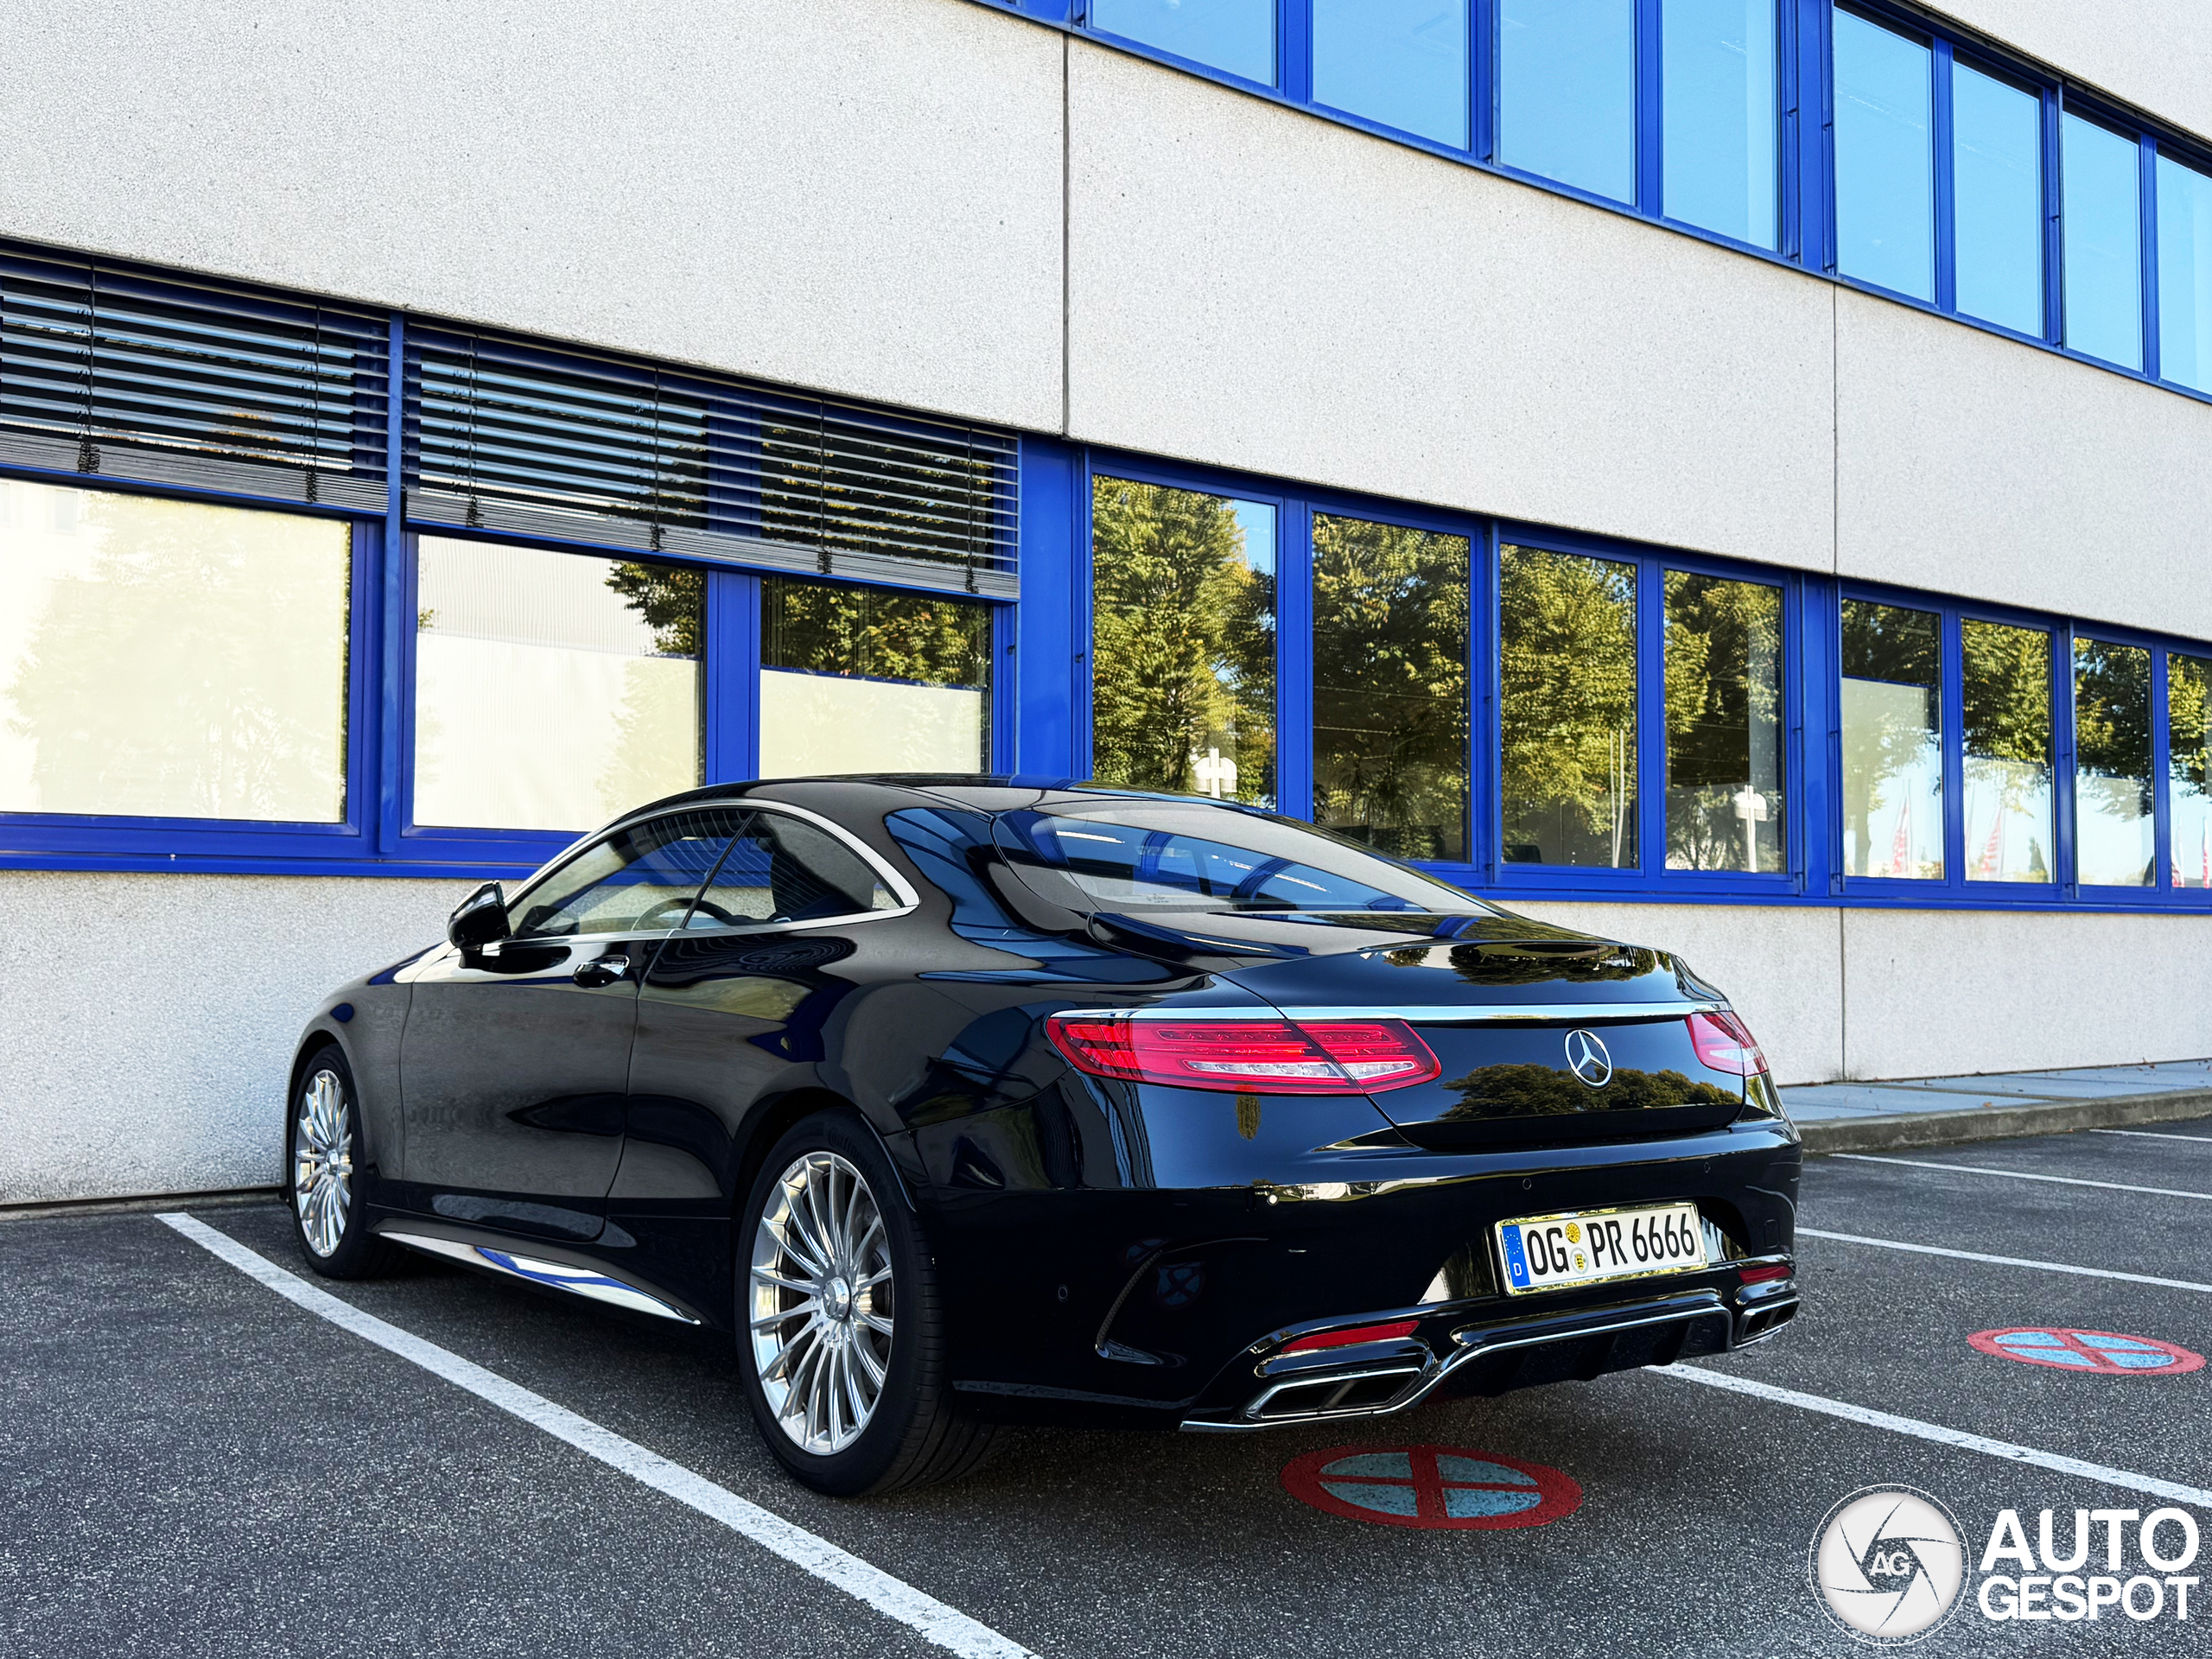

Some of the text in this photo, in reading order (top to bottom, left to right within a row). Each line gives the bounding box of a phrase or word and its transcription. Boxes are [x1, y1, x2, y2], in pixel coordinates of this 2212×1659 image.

[1527, 1213, 1695, 1275] OG PR 6666
[1513, 1262, 1522, 1276] D
